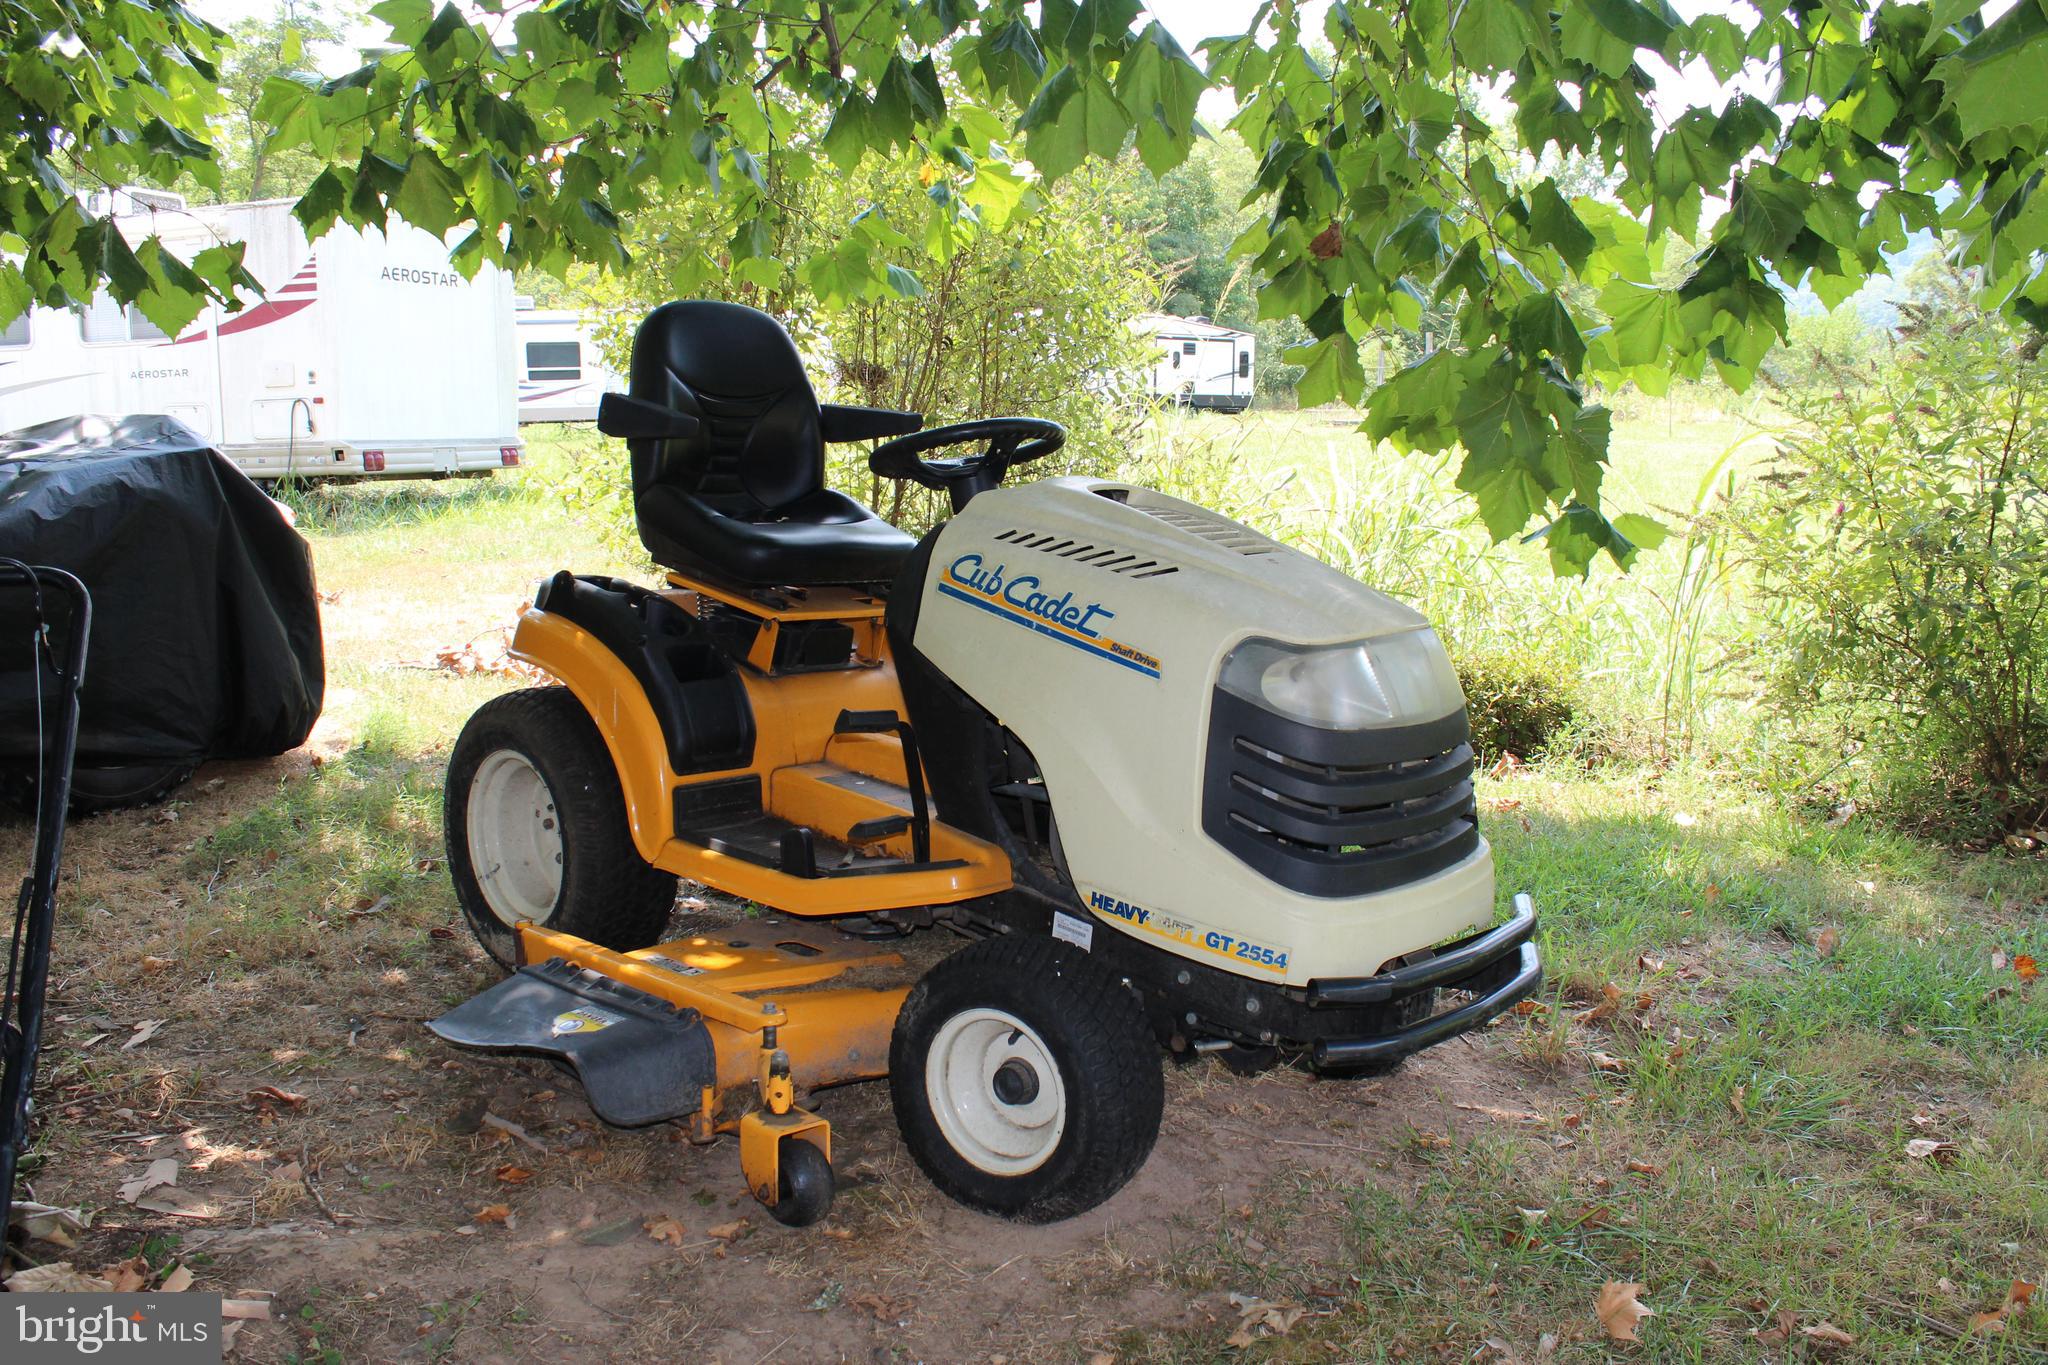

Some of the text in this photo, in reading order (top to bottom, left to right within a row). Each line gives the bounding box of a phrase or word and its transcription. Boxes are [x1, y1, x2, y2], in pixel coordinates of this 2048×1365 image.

[381, 266, 458, 287] AEROSTAR
[130, 368, 189, 379] AEROSTAR
[949, 553, 1116, 639] Cub Cadet
[1110, 642, 1158, 669] Shaft Drive
[1205, 931, 1234, 952] GT
[1236, 942, 1288, 969] 2554
